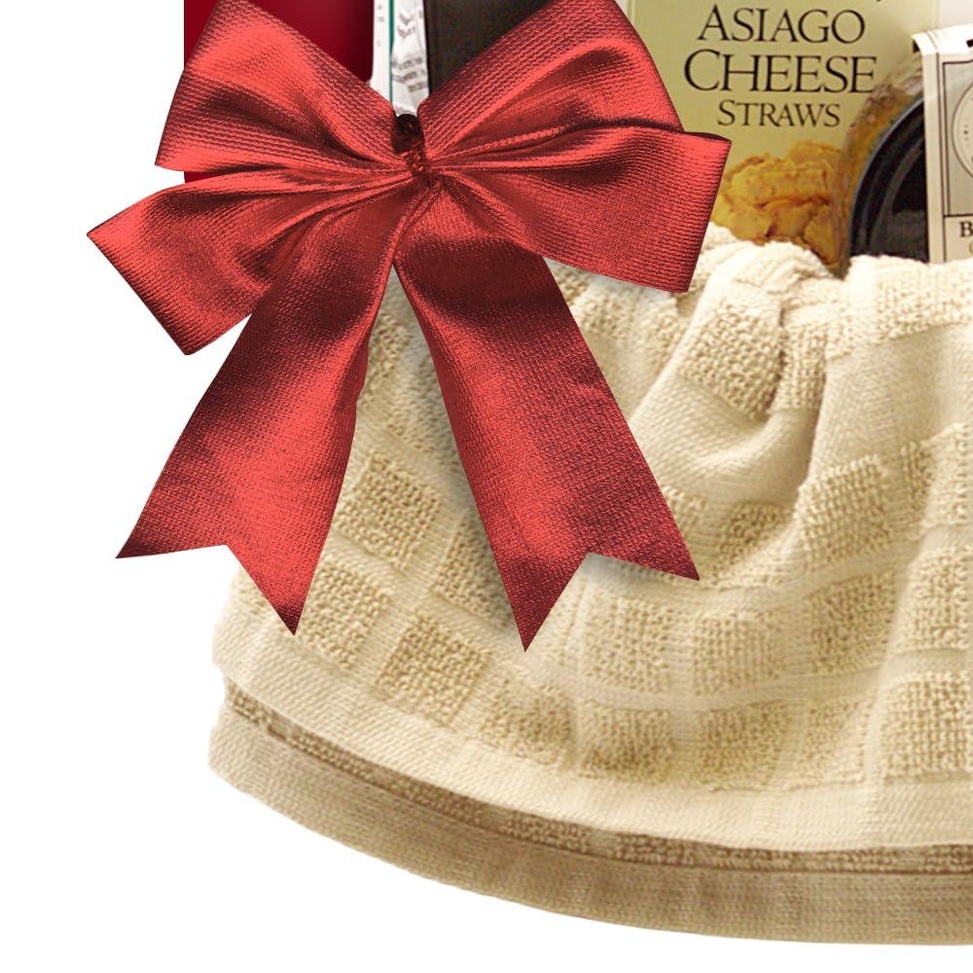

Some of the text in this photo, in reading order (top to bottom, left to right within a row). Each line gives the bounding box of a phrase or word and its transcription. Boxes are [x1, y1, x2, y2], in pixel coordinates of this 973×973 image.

[696, 3, 866, 45] ASIAGO
[683, 48, 878, 95] CHEESE
[717, 99, 841, 128] STRAWS
